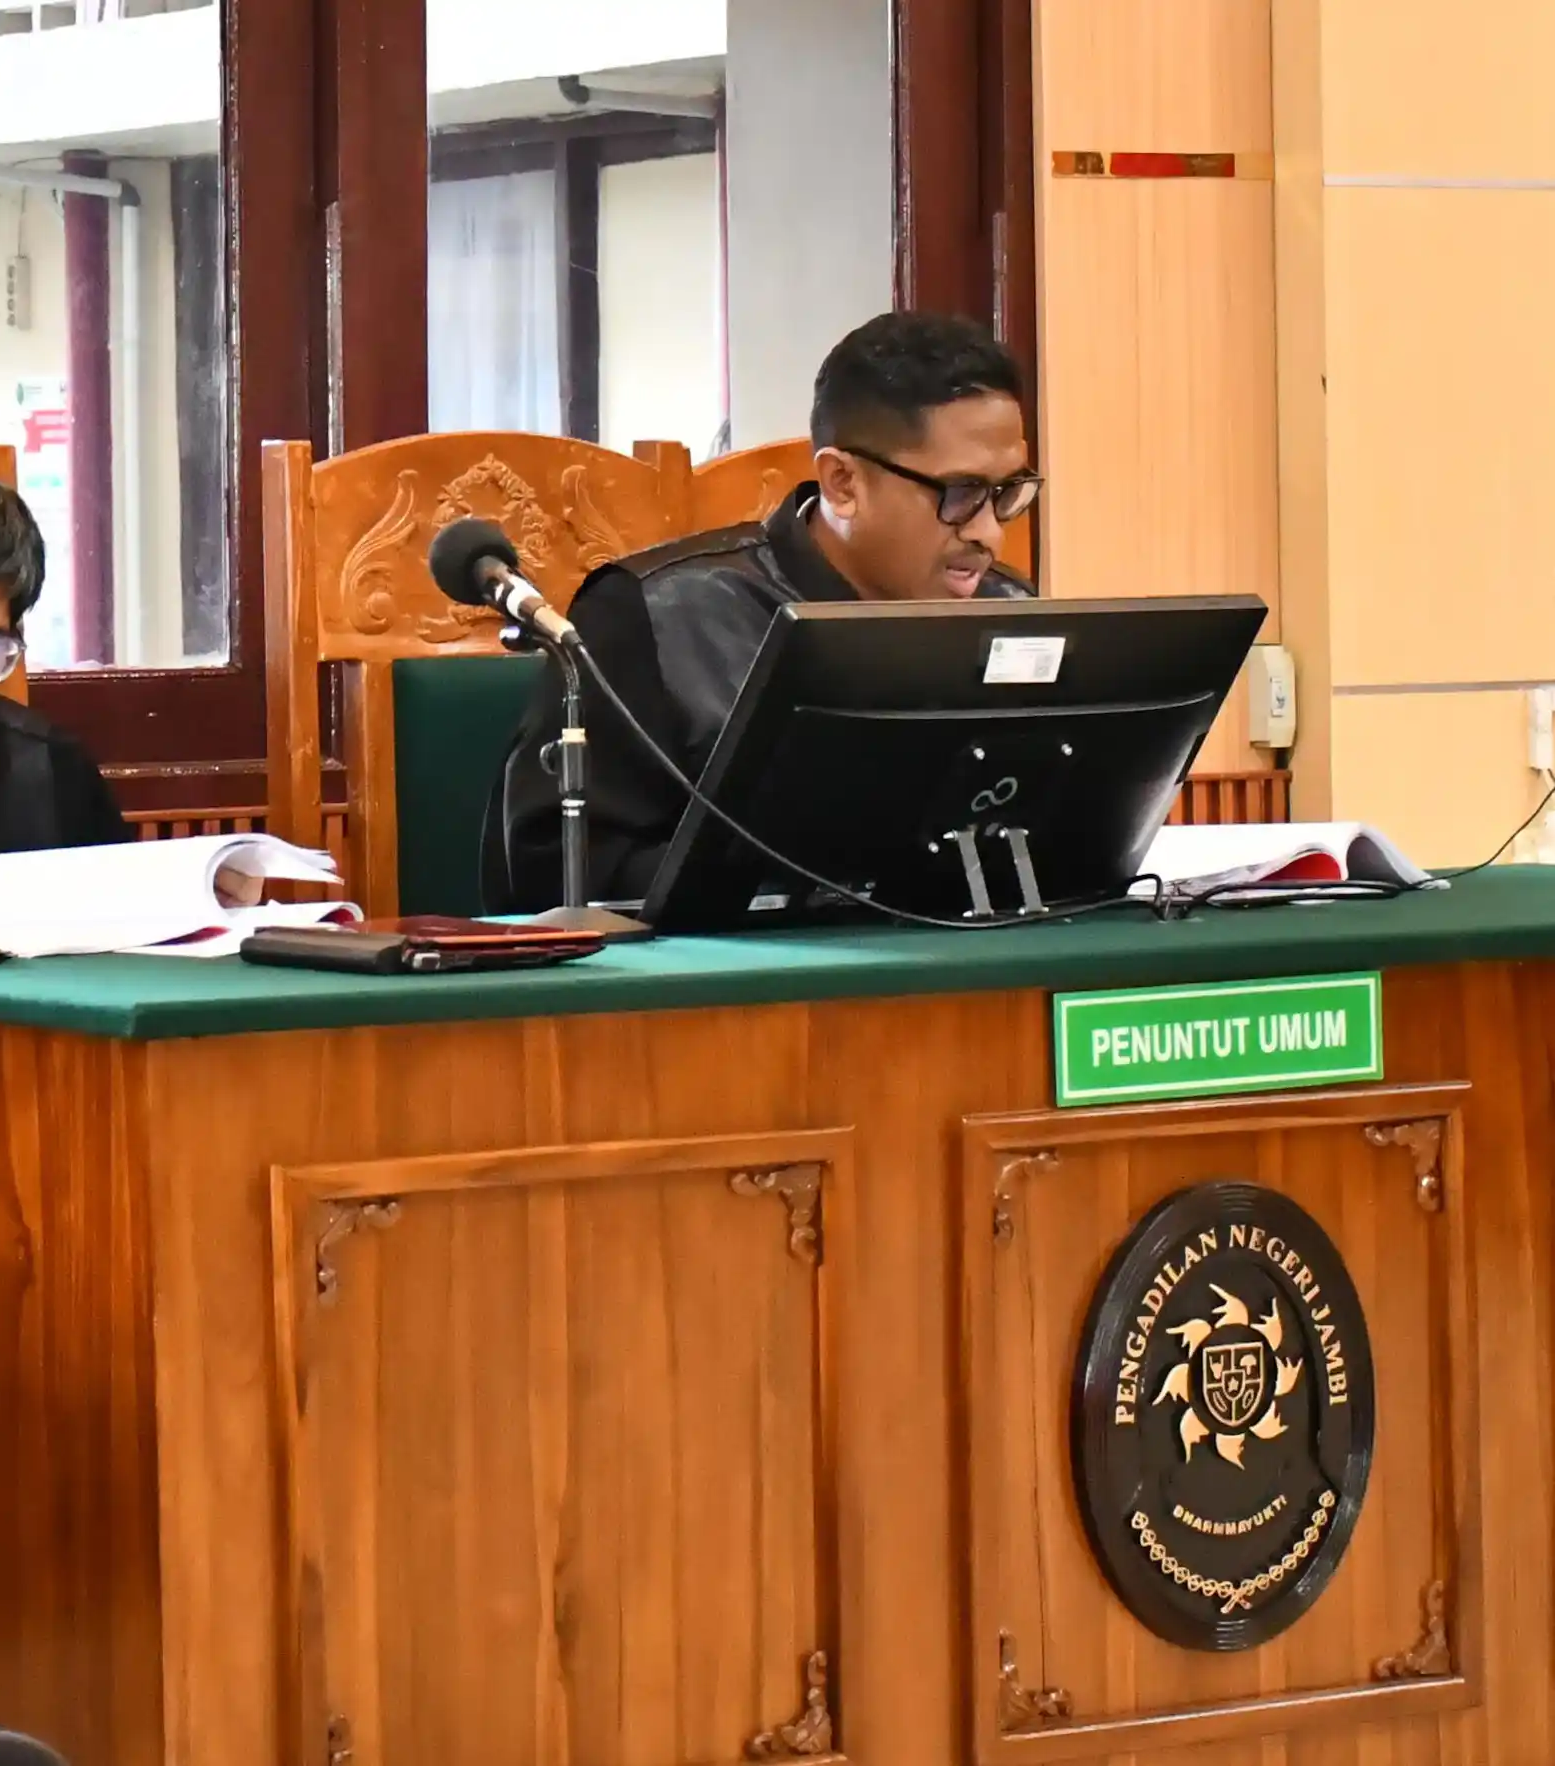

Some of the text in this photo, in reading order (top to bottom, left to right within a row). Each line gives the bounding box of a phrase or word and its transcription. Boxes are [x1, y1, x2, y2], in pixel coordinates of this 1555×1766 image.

[1091, 1009, 1347, 1068] PENUNTUT UMUM
[1115, 1223, 1348, 1425] PENGADILAN NEGERI JAMBI
